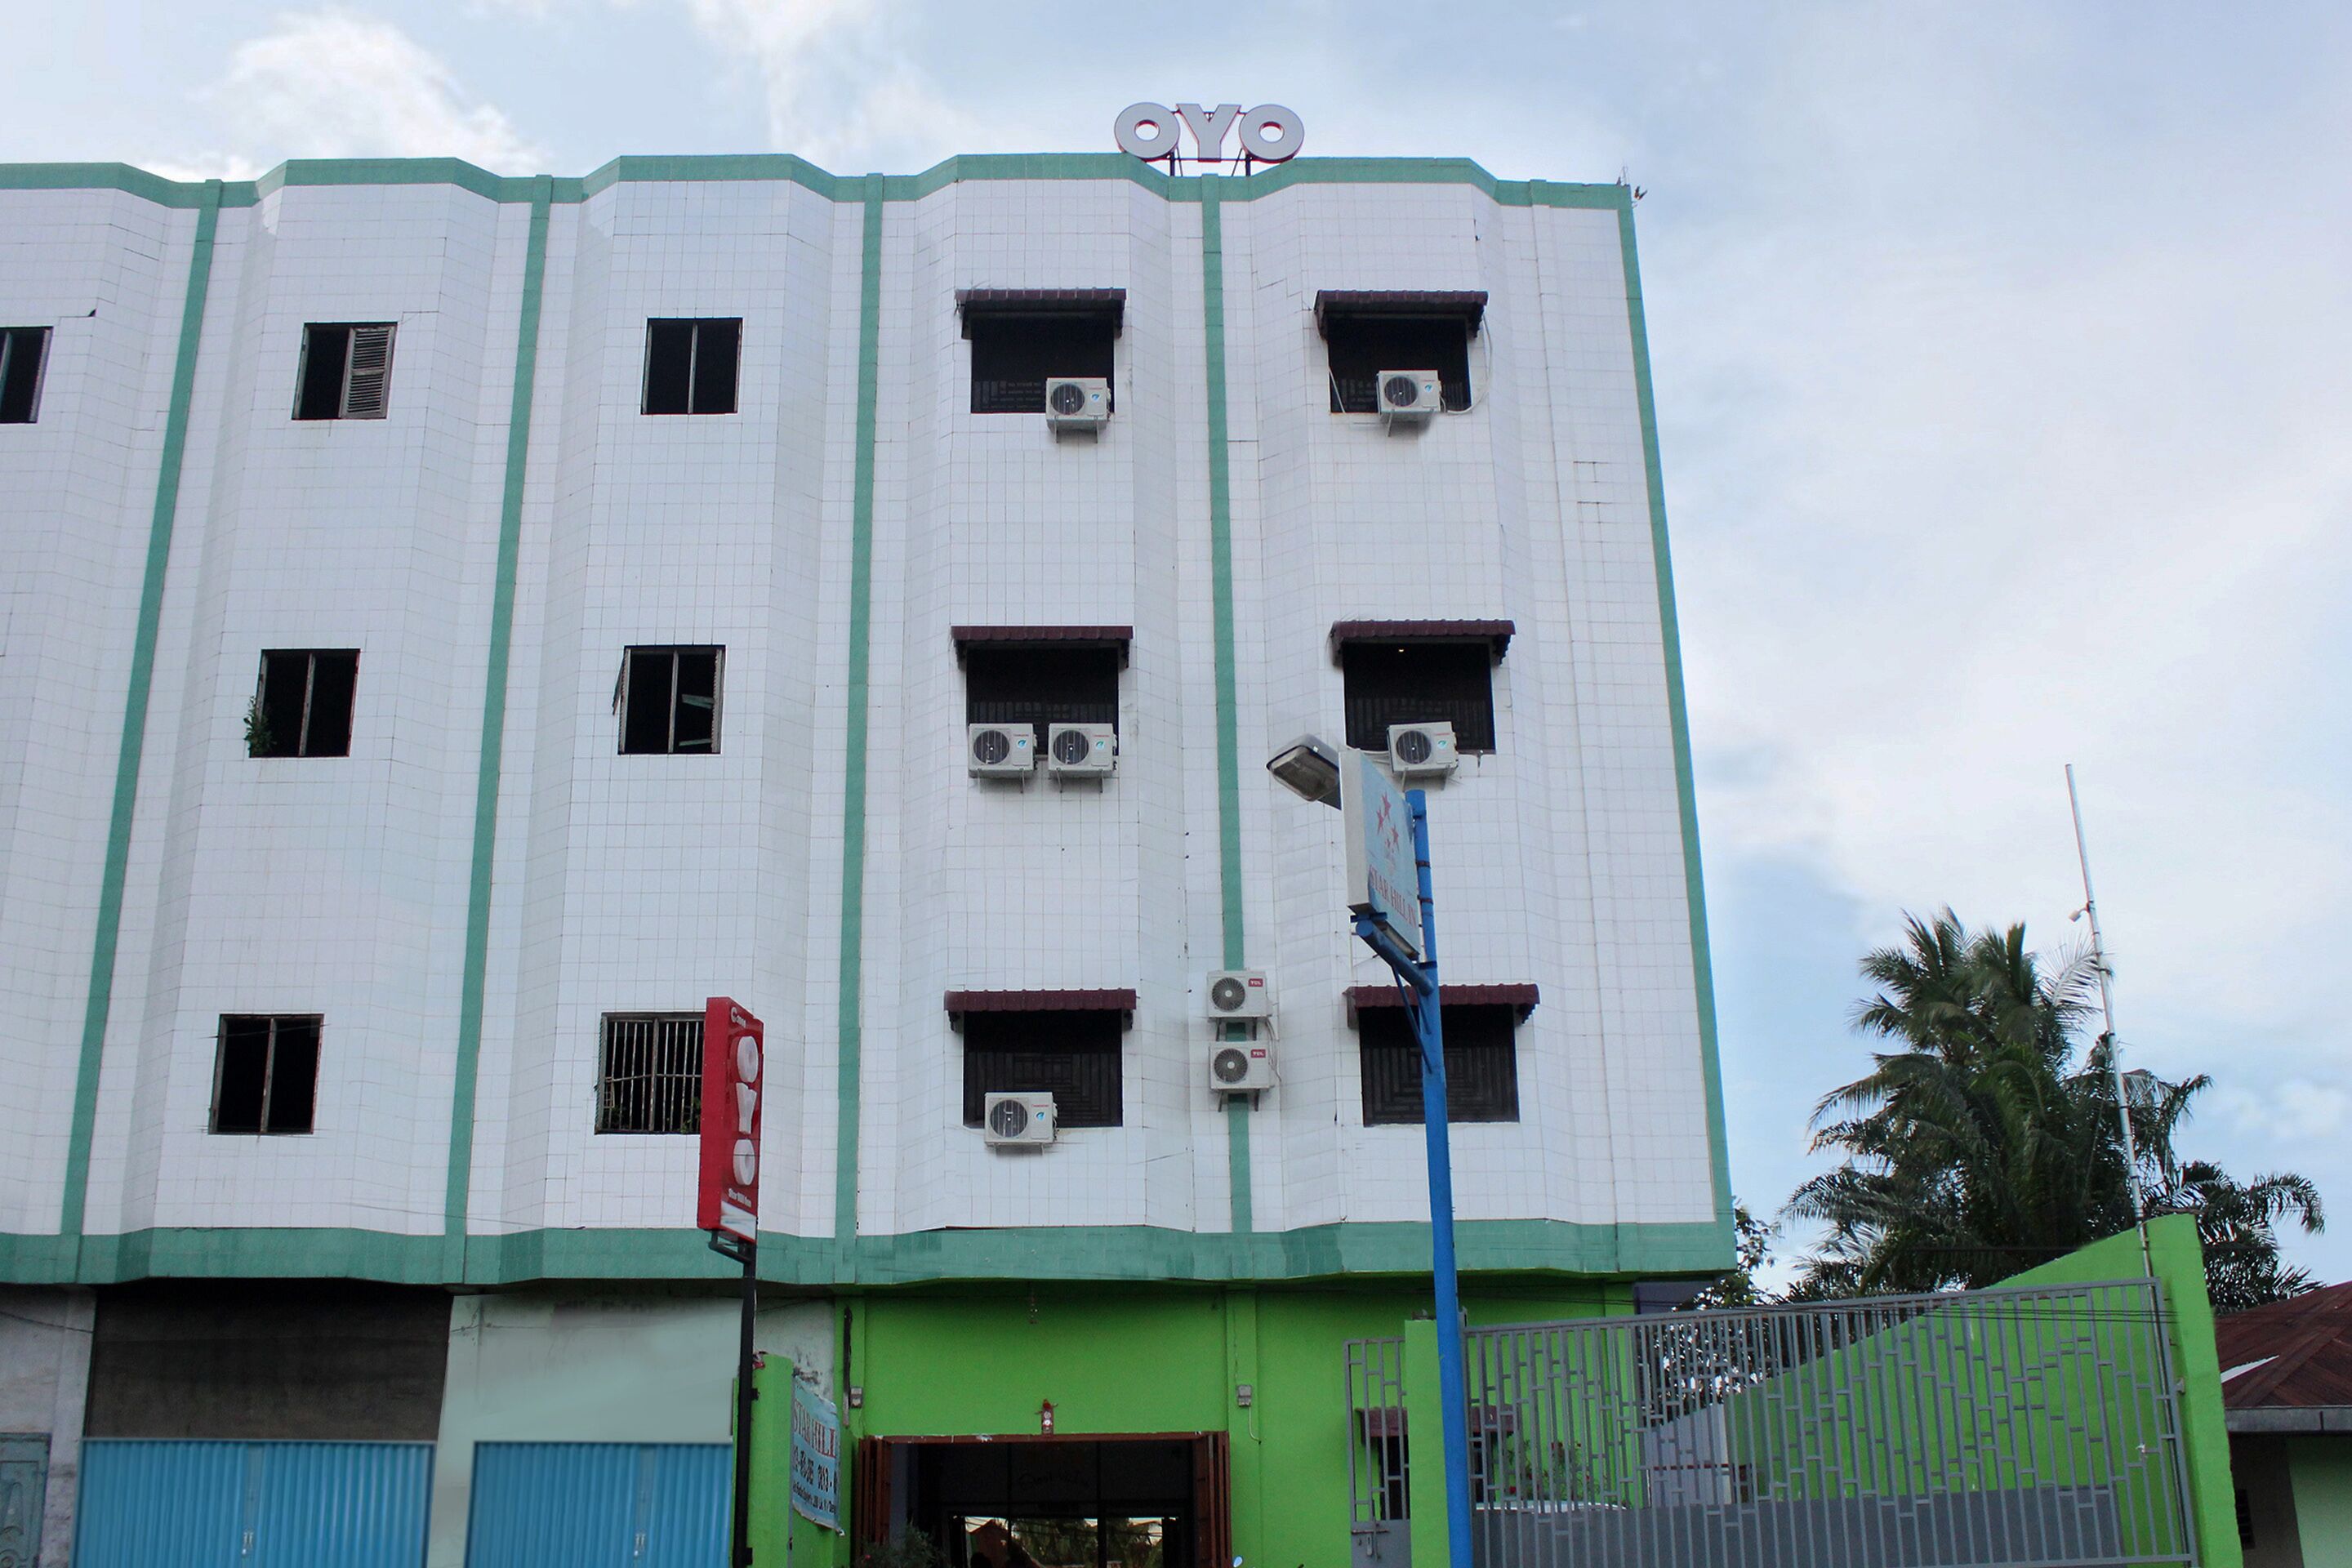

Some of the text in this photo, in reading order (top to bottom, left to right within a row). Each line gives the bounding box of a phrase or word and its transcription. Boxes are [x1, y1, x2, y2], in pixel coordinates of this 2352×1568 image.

[1114, 102, 1304, 163] OYO
[1390, 885, 1408, 920] HILL
[733, 1036, 760, 1186] OYO
[793, 1398, 810, 1445] STAR
